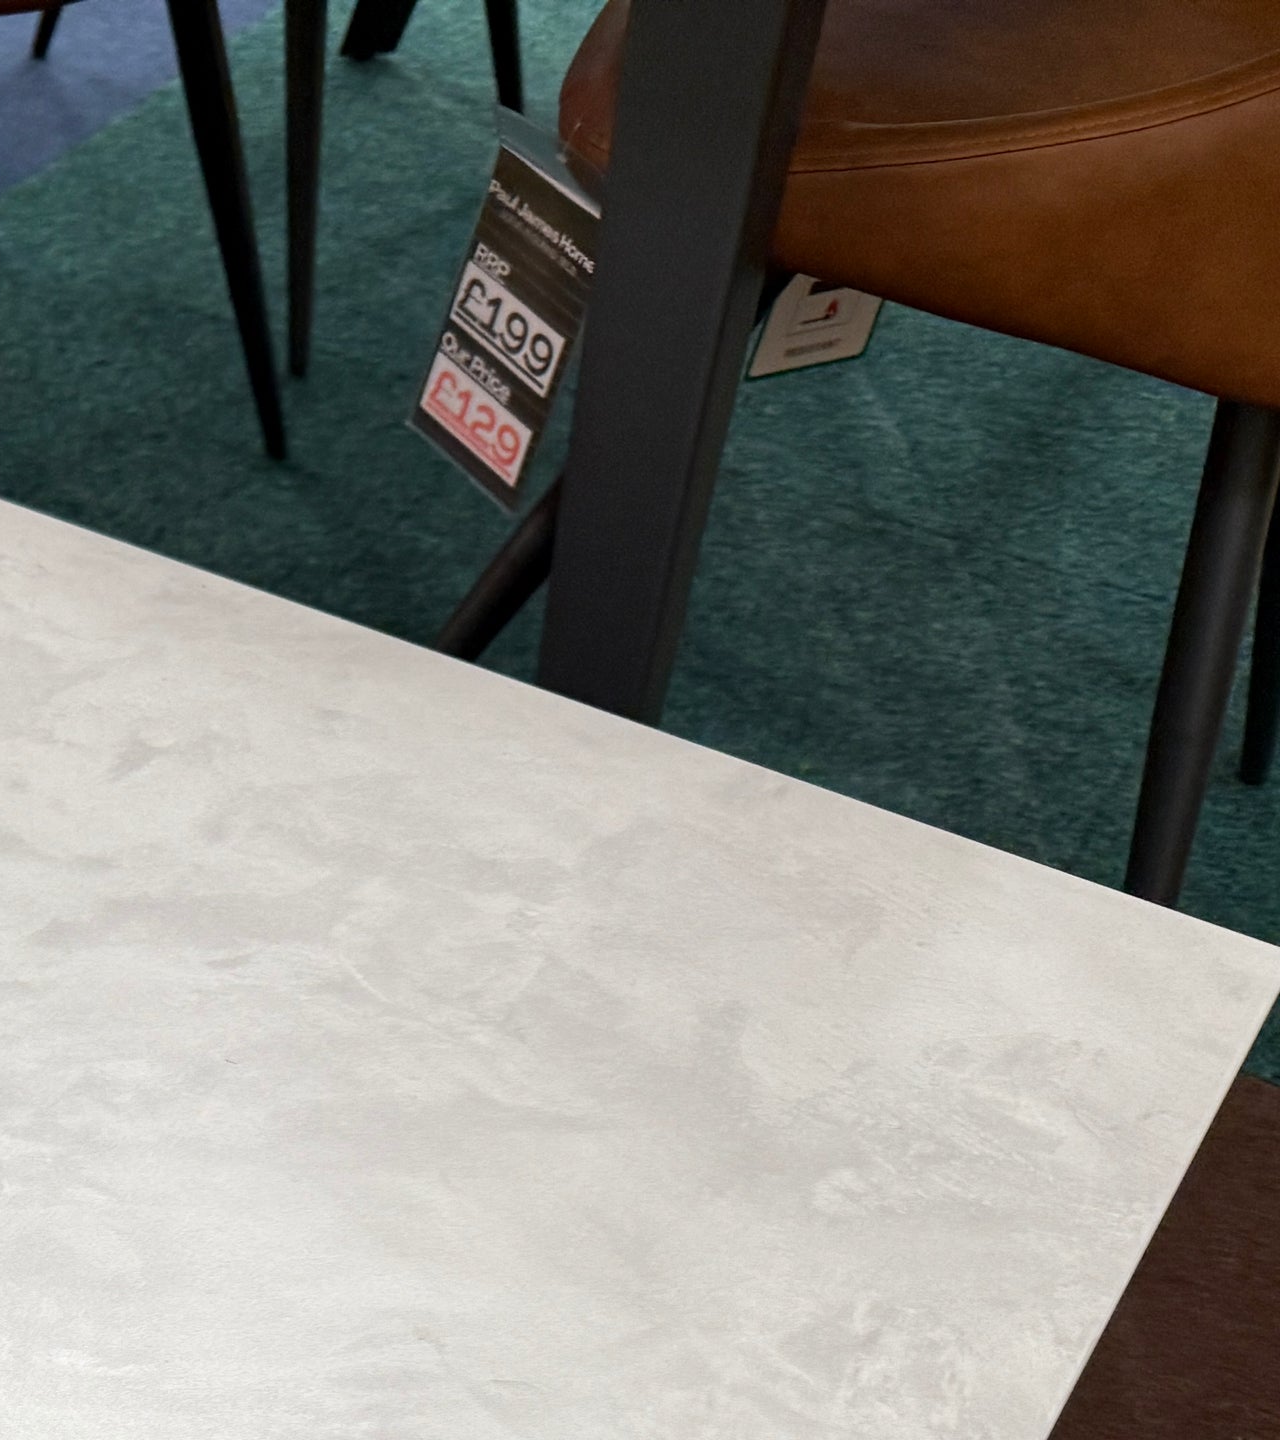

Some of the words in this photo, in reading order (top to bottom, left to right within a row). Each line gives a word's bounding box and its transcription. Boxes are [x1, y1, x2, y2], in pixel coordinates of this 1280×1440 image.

[474, 242, 511, 276] RRP
[488, 179, 519, 210] Paul
[518, 203, 559, 243] James
[559, 234, 595, 274] Home
[442, 332, 470, 364] Our
[470, 355, 511, 404] Price
[456, 277, 553, 377] £199
[429, 371, 521, 468] £129
